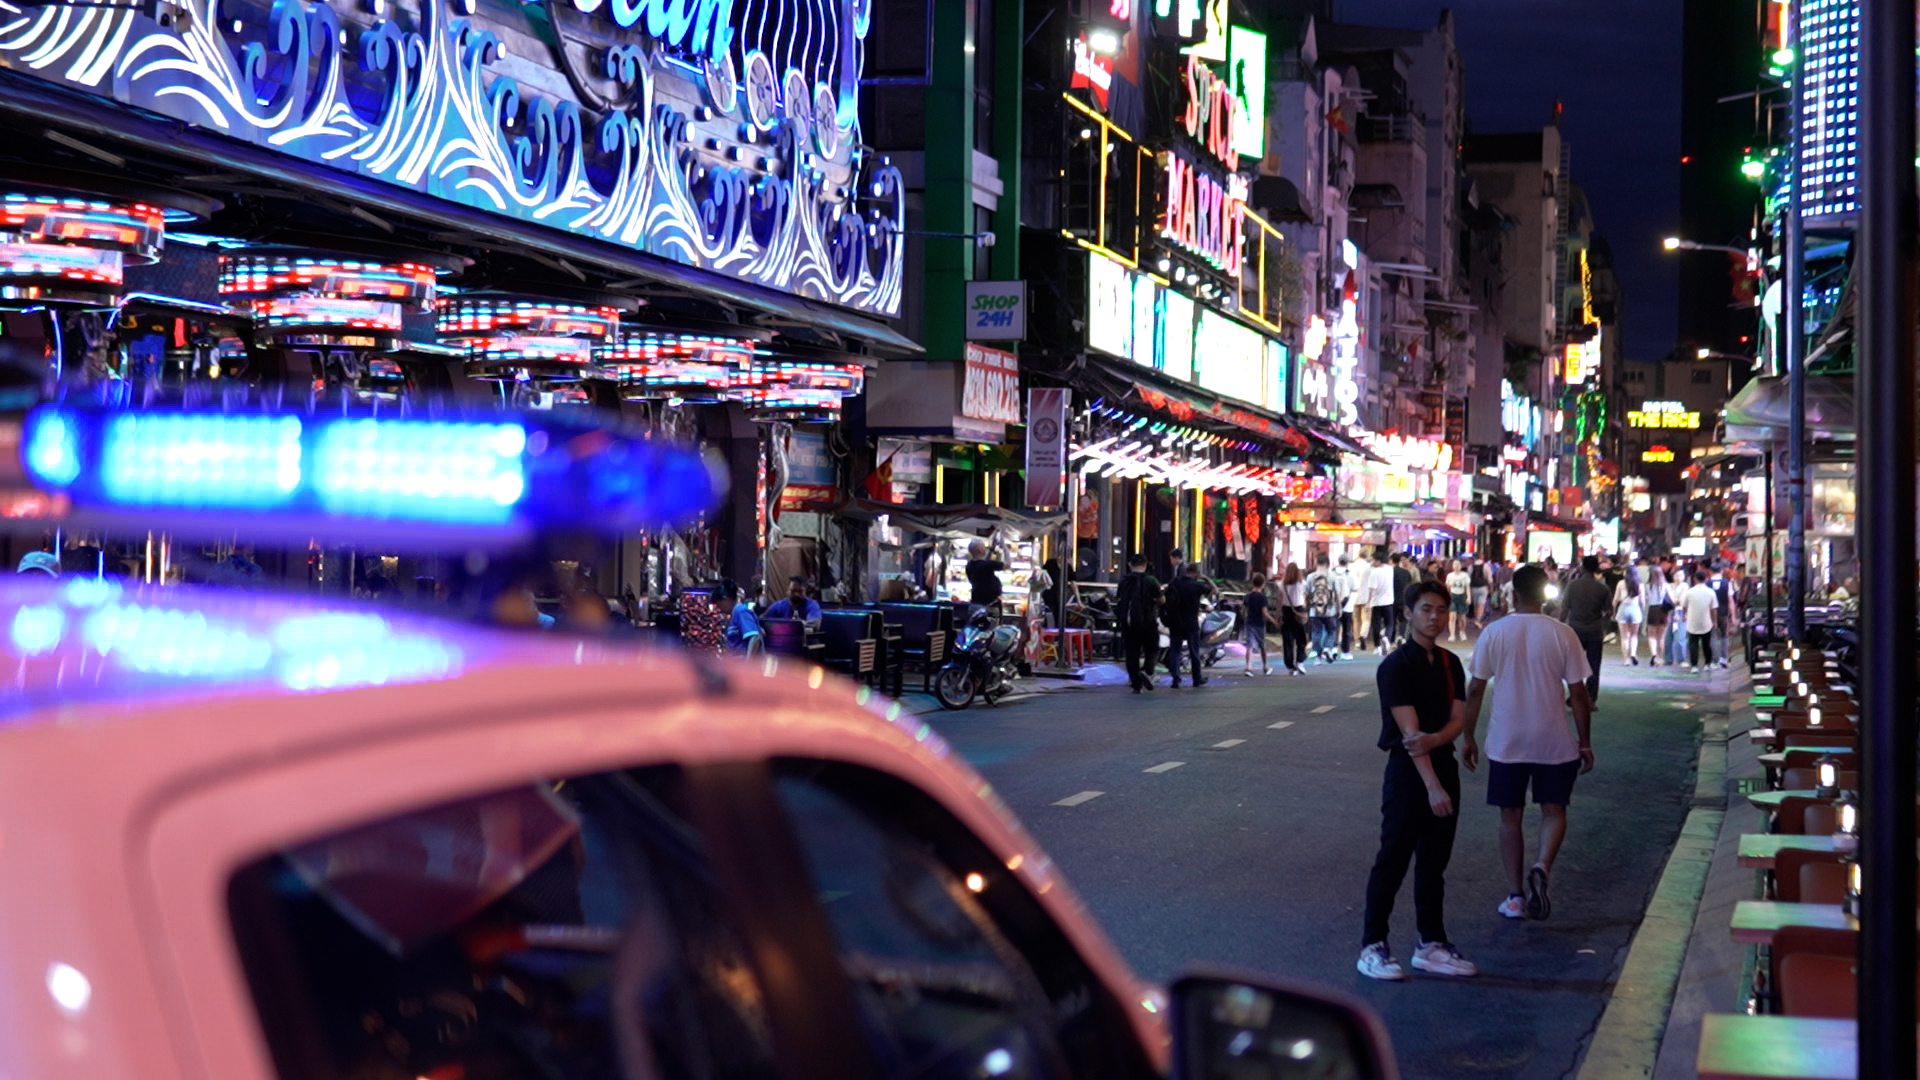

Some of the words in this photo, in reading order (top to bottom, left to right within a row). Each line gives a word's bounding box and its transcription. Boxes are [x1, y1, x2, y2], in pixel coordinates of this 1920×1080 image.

[1185, 52, 1239, 171] SPICE
[1166, 151, 1244, 277] MARKET
[971, 294, 1019, 310] SHOP
[976, 310, 1014, 327] 24H
[1627, 411, 1661, 428] THE
[1662, 411, 1700, 429] RICE
